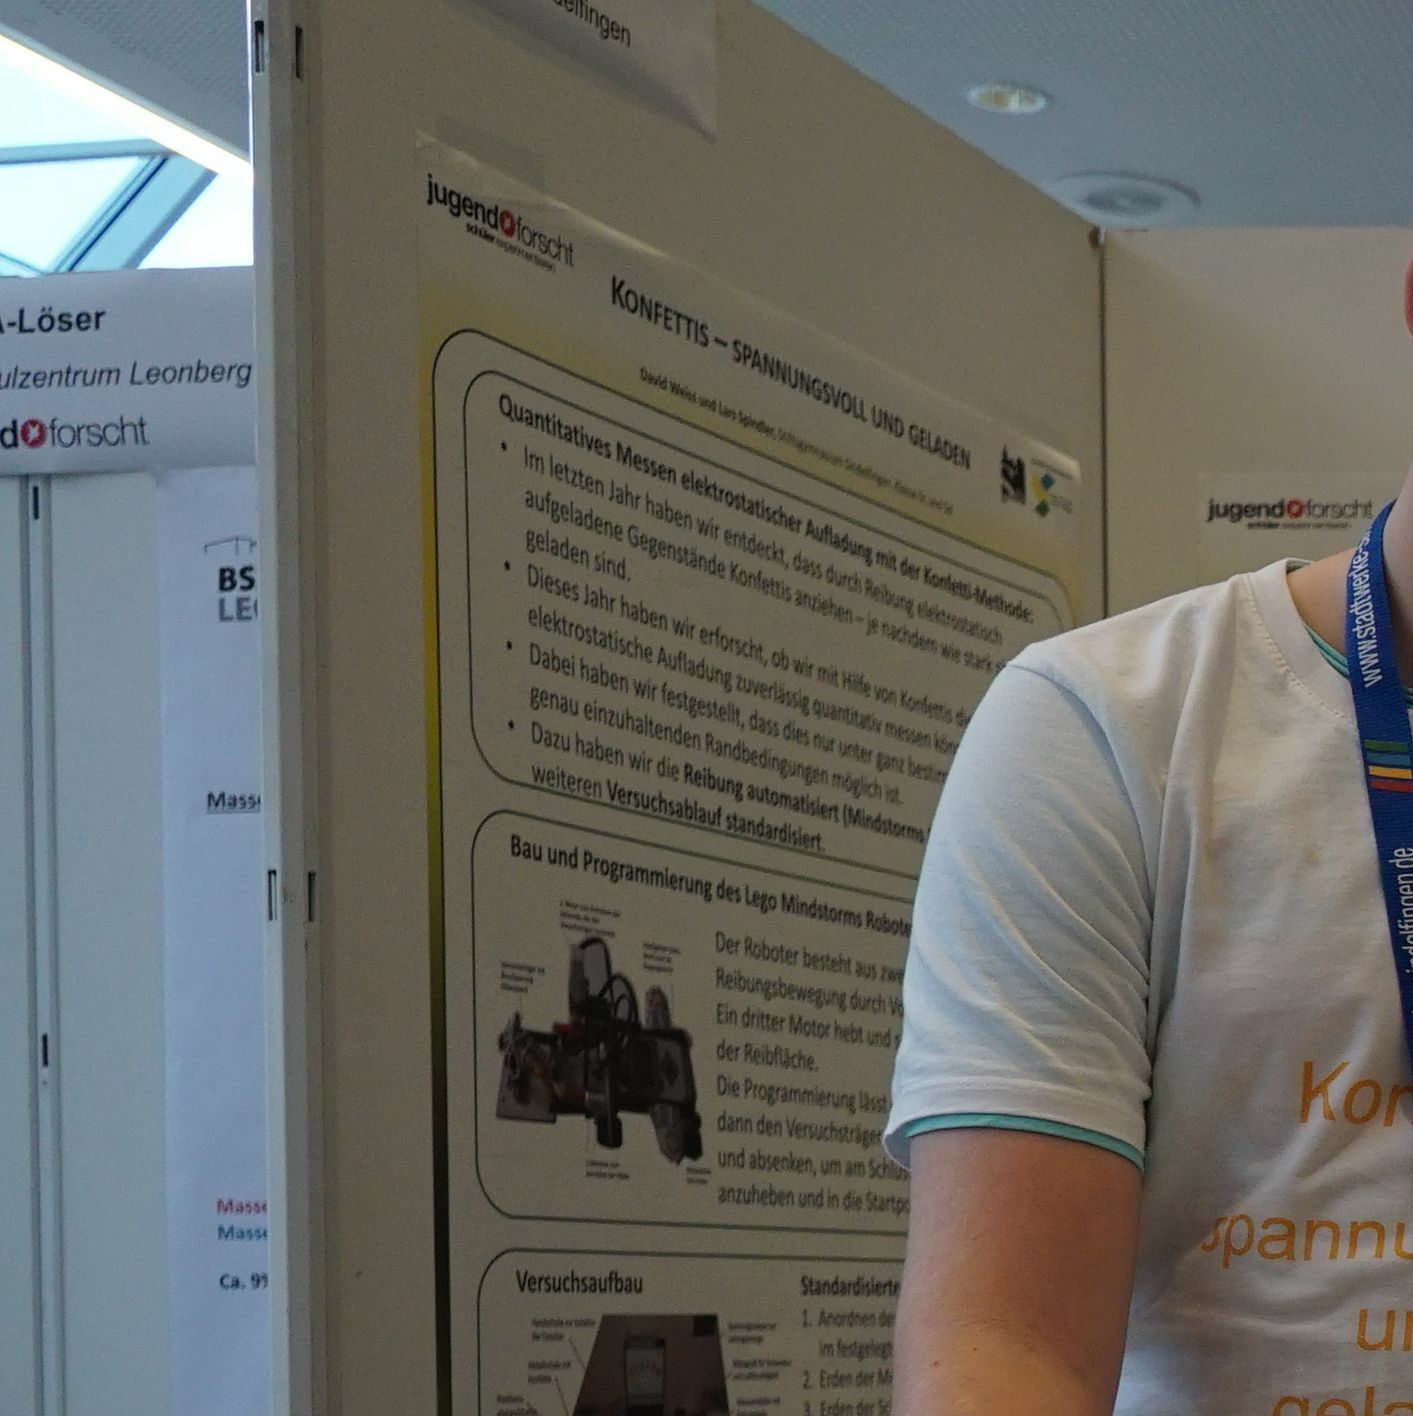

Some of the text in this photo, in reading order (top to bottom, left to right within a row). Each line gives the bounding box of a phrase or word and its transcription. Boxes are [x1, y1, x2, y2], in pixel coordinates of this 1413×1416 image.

[426, 173, 499, 231] jugend
[517, 217, 574, 267] forscht
[0, 306, 106, 335] -Löser
[0, 358, 252, 391] ulzentrum Leonberg
[50, 414, 150, 449] forscht
[499, 393, 610, 459] Quantitatives
[617, 441, 676, 484] Messen
[681, 470, 801, 533] elektrostatischer
[524, 445, 544, 474] Im
[550, 454, 604, 497] letzten
[608, 480, 640, 510] Jahr
[645, 492, 692, 530] haben
[696, 518, 719, 540] wir
[1206, 498, 1373, 522] jugend forscht
[525, 490, 622, 555] aufgeladene
[627, 524, 725, 579] Gegenstände
[526, 529, 630, 582] geladen sind.
[218, 566, 255, 592] BS
[528, 563, 578, 602] Dieses
[584, 584, 616, 613] Jahr
[620, 594, 667, 631] haben
[672, 617, 694, 639] wir
[528, 605, 732, 694] elektrostatische Aufladung
[530, 642, 574, 677] Dabei
[580, 657, 628, 693] haben
[632, 679, 656, 701] wir
[532, 720, 570, 752] Dazu
[576, 732, 623, 766] haben
[628, 751, 652, 773] wir
[657, 756, 679, 782] die
[684, 762, 742, 803] Reibung
[532, 765, 601, 798] weiteren
[606, 779, 722, 828] Versuchsablauf
[510, 834, 542, 862] Bau
[548, 847, 577, 869] und
[583, 850, 711, 903] Programmierung
[716, 879, 740, 904] des
[745, 885, 777, 914] Lego
[516, 1270, 642, 1294] Versuchsaufbau
